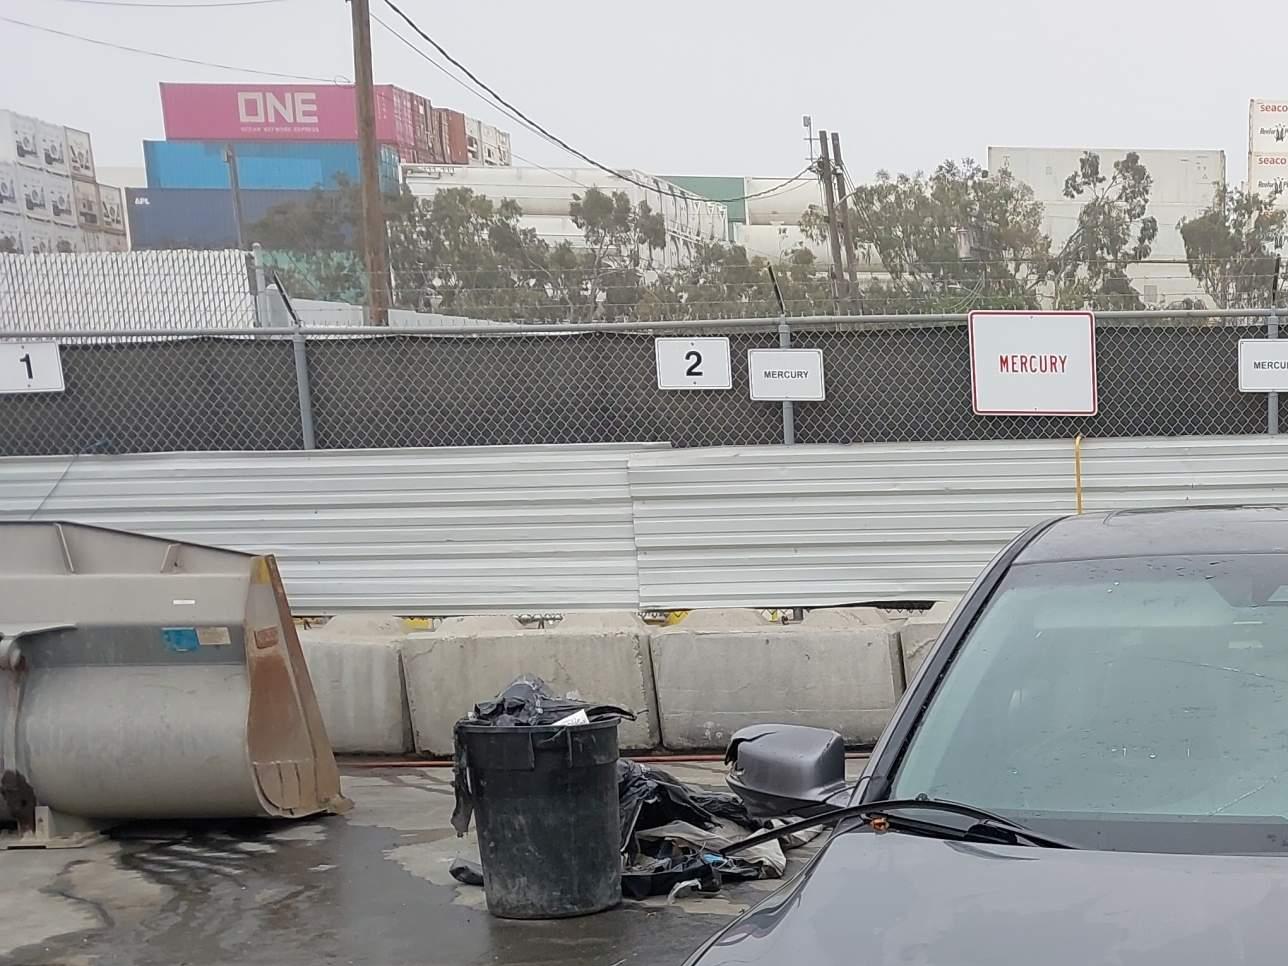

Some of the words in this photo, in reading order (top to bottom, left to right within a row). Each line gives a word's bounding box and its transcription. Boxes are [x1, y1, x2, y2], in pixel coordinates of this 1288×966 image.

[238, 92, 319, 123] ONE
[1260, 103, 1288, 112] seaco
[1258, 157, 1287, 165] seaco
[19, 353, 33, 379] 1
[685, 351, 703, 377] 2
[1000, 355, 1067, 373] MERCURY
[764, 370, 809, 379] MERCURY
